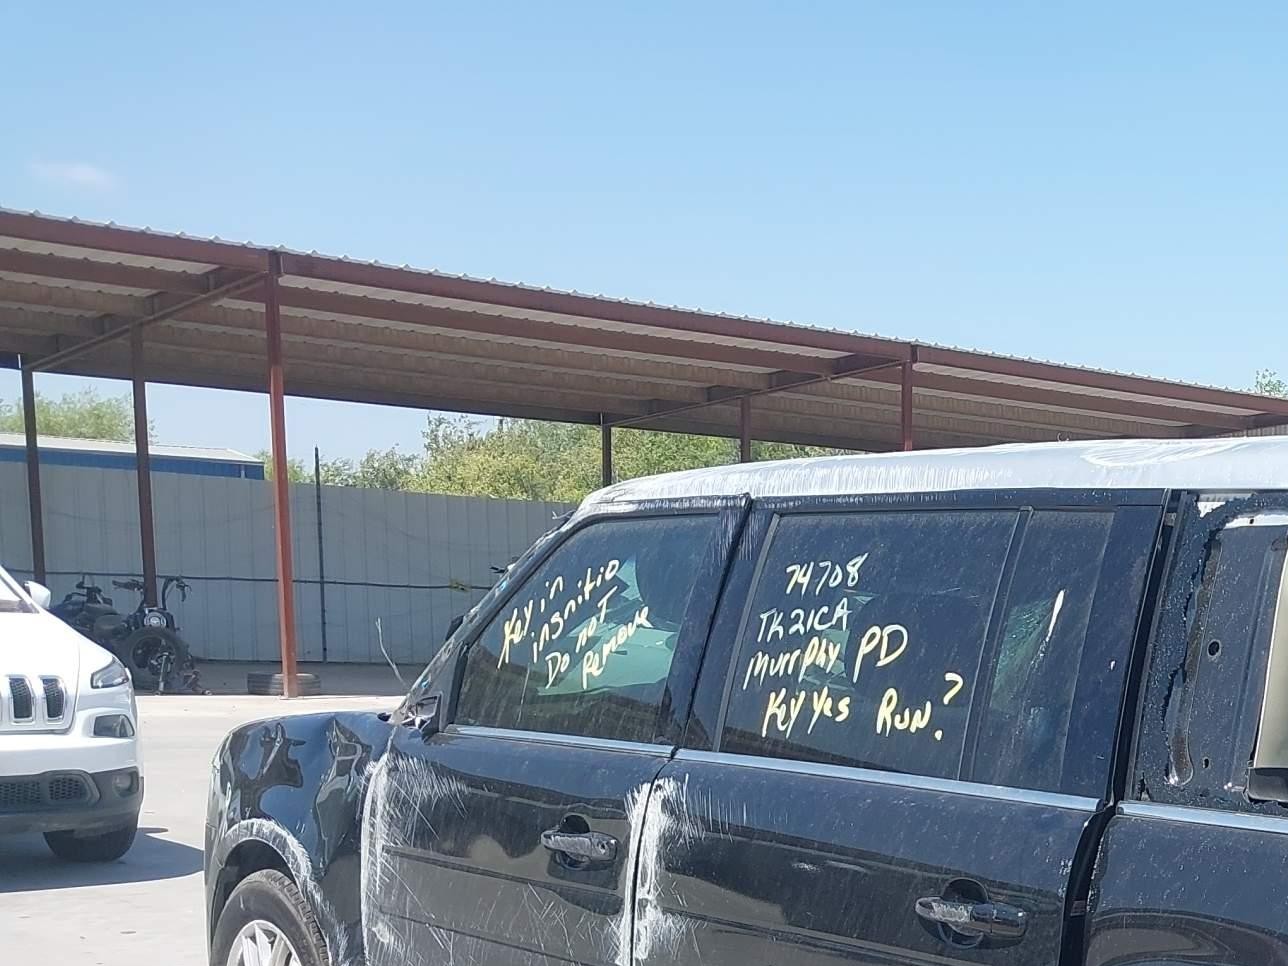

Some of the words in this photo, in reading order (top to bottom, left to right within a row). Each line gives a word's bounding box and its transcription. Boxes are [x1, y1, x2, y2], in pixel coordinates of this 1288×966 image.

[785, 552, 870, 597] 74708
[545, 651, 571, 689] Do
[852, 624, 909, 684] PD
